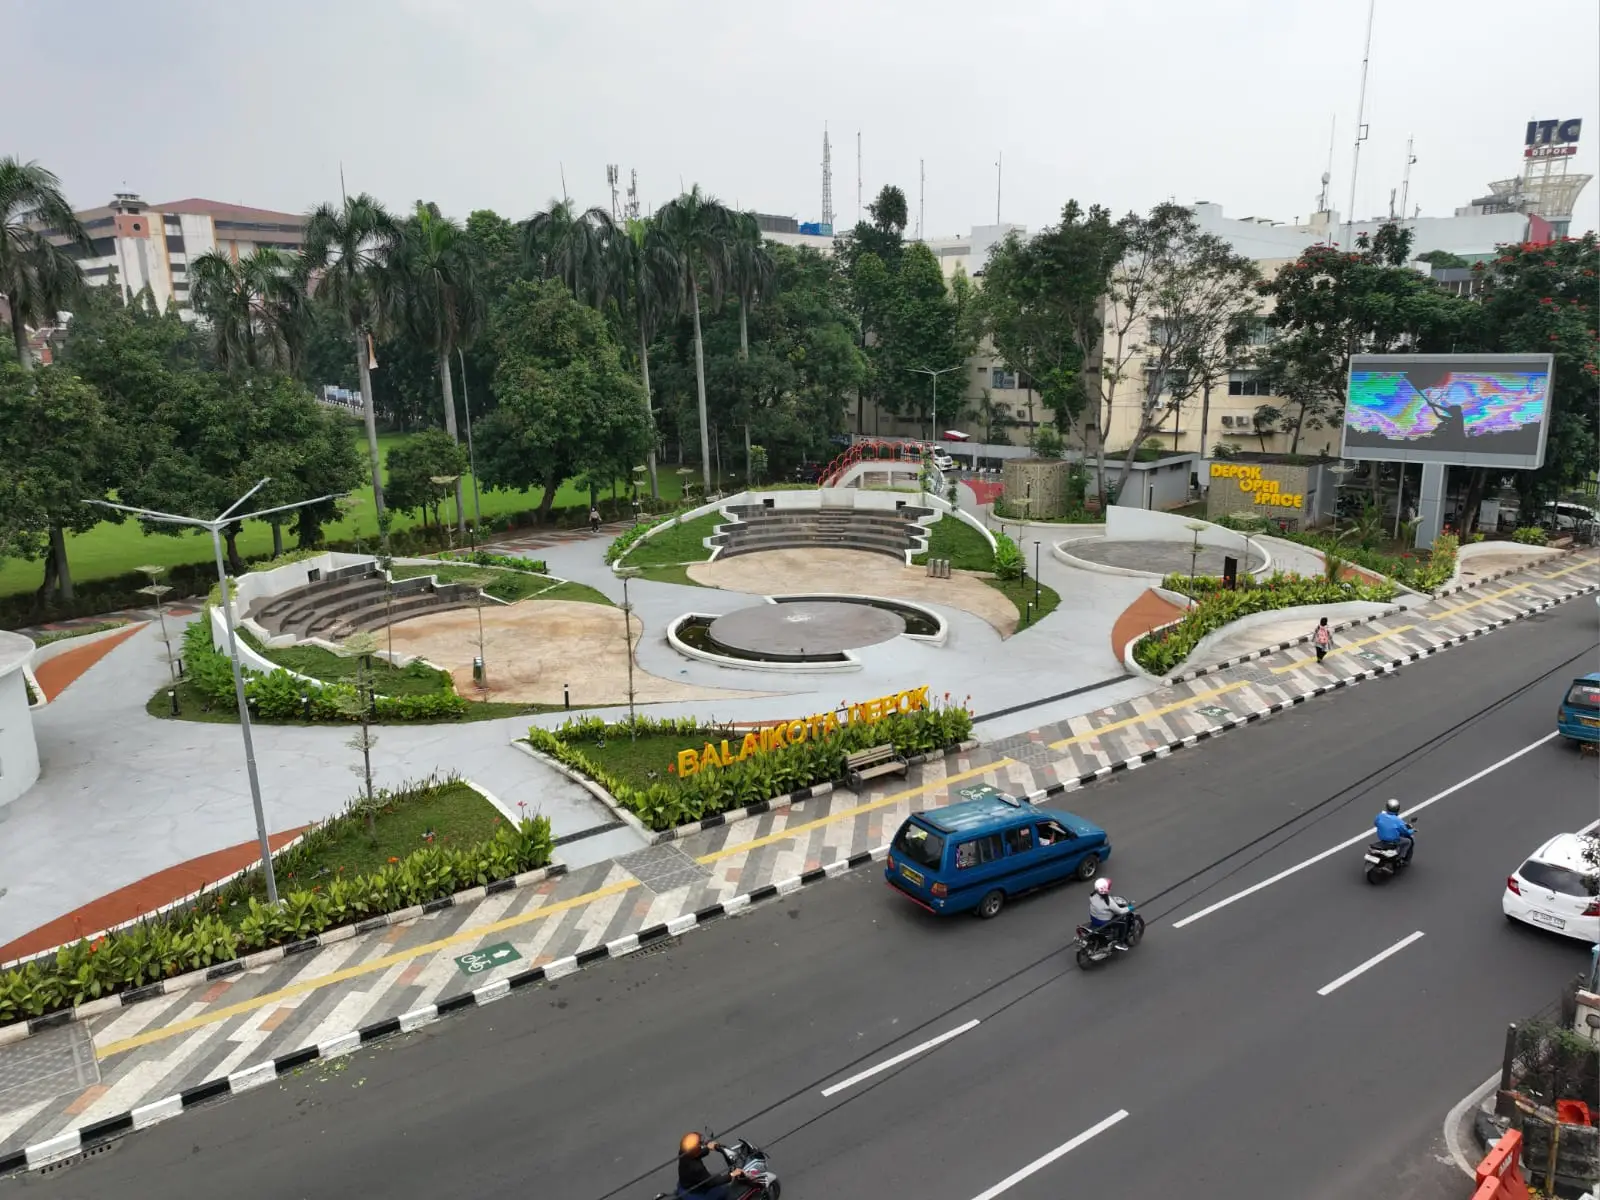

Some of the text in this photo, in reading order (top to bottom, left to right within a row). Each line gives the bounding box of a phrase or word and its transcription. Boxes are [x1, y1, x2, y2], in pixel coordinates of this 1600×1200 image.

[1525, 118, 1582, 145] ITC
[1532, 148, 1568, 156] DEPOK
[1210, 463, 1262, 480] DEPOK
[1239, 477, 1280, 494] OPEN
[1254, 492, 1304, 509] SPACE
[677, 684, 930, 778] BALAIKOTA DEPOK
